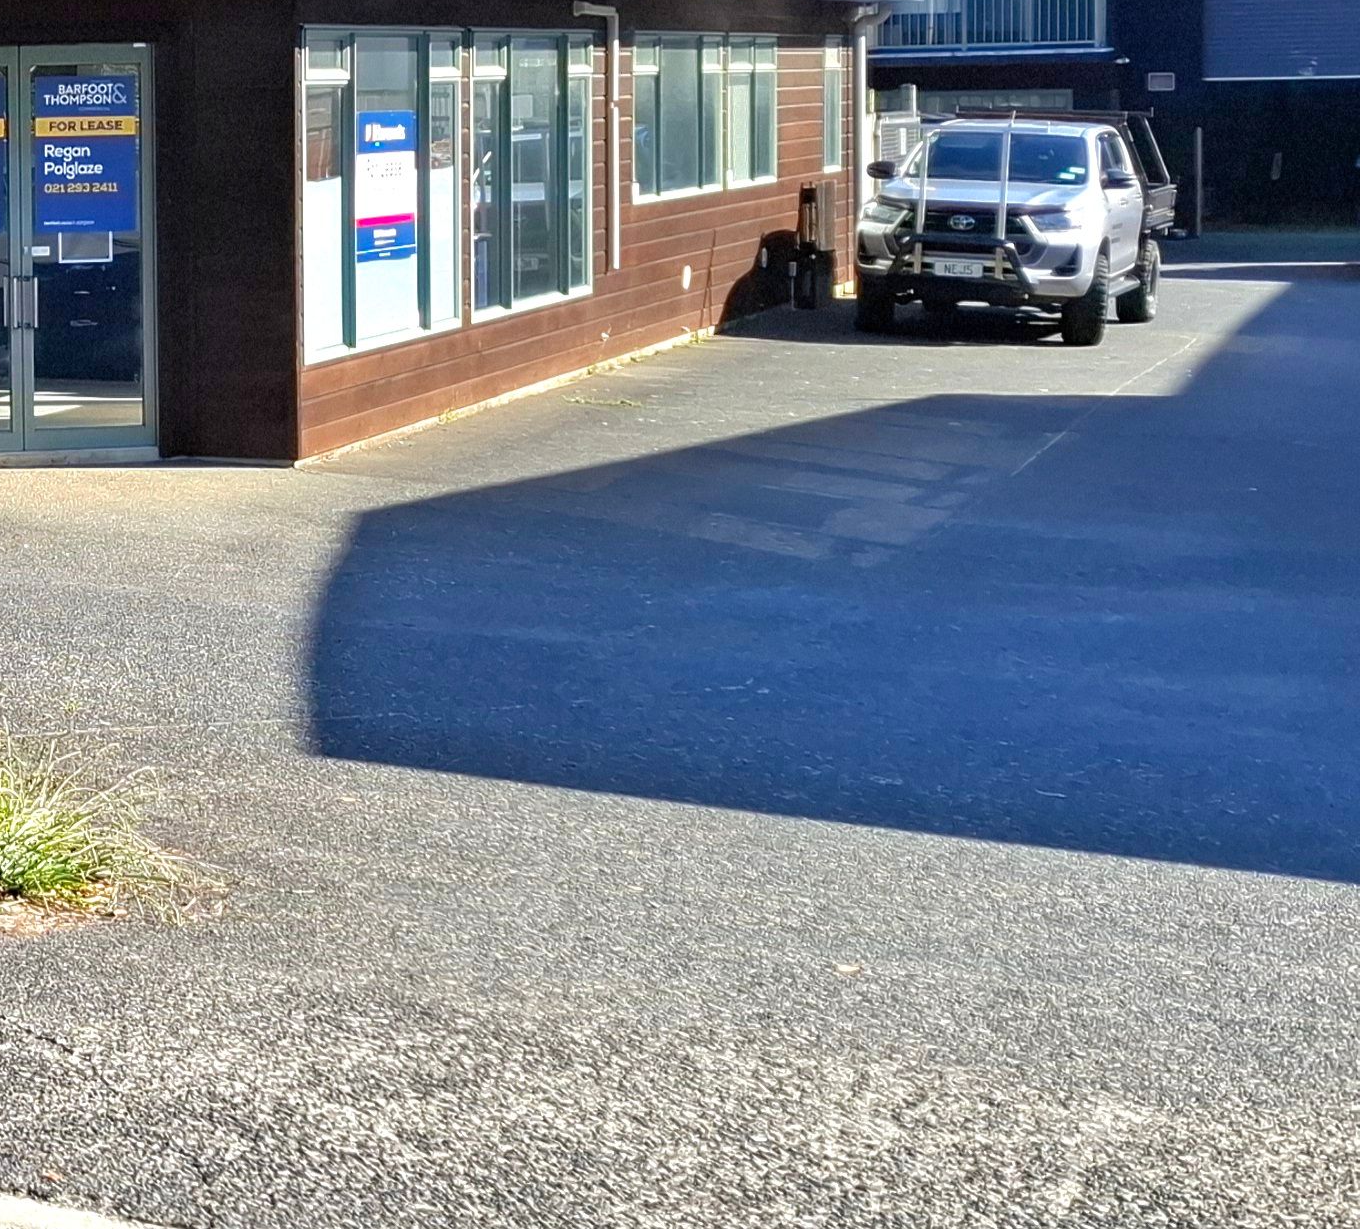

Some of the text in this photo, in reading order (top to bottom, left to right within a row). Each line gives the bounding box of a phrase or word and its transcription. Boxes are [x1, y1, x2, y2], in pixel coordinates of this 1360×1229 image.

[58, 83, 114, 95] BARFOOT
[43, 94, 111, 106] THOMPSON
[49, 120, 123, 132] FOR LEASE
[44, 144, 91, 162] Regan
[44, 161, 103, 180] Polglaze
[44, 183, 65, 194] 021
